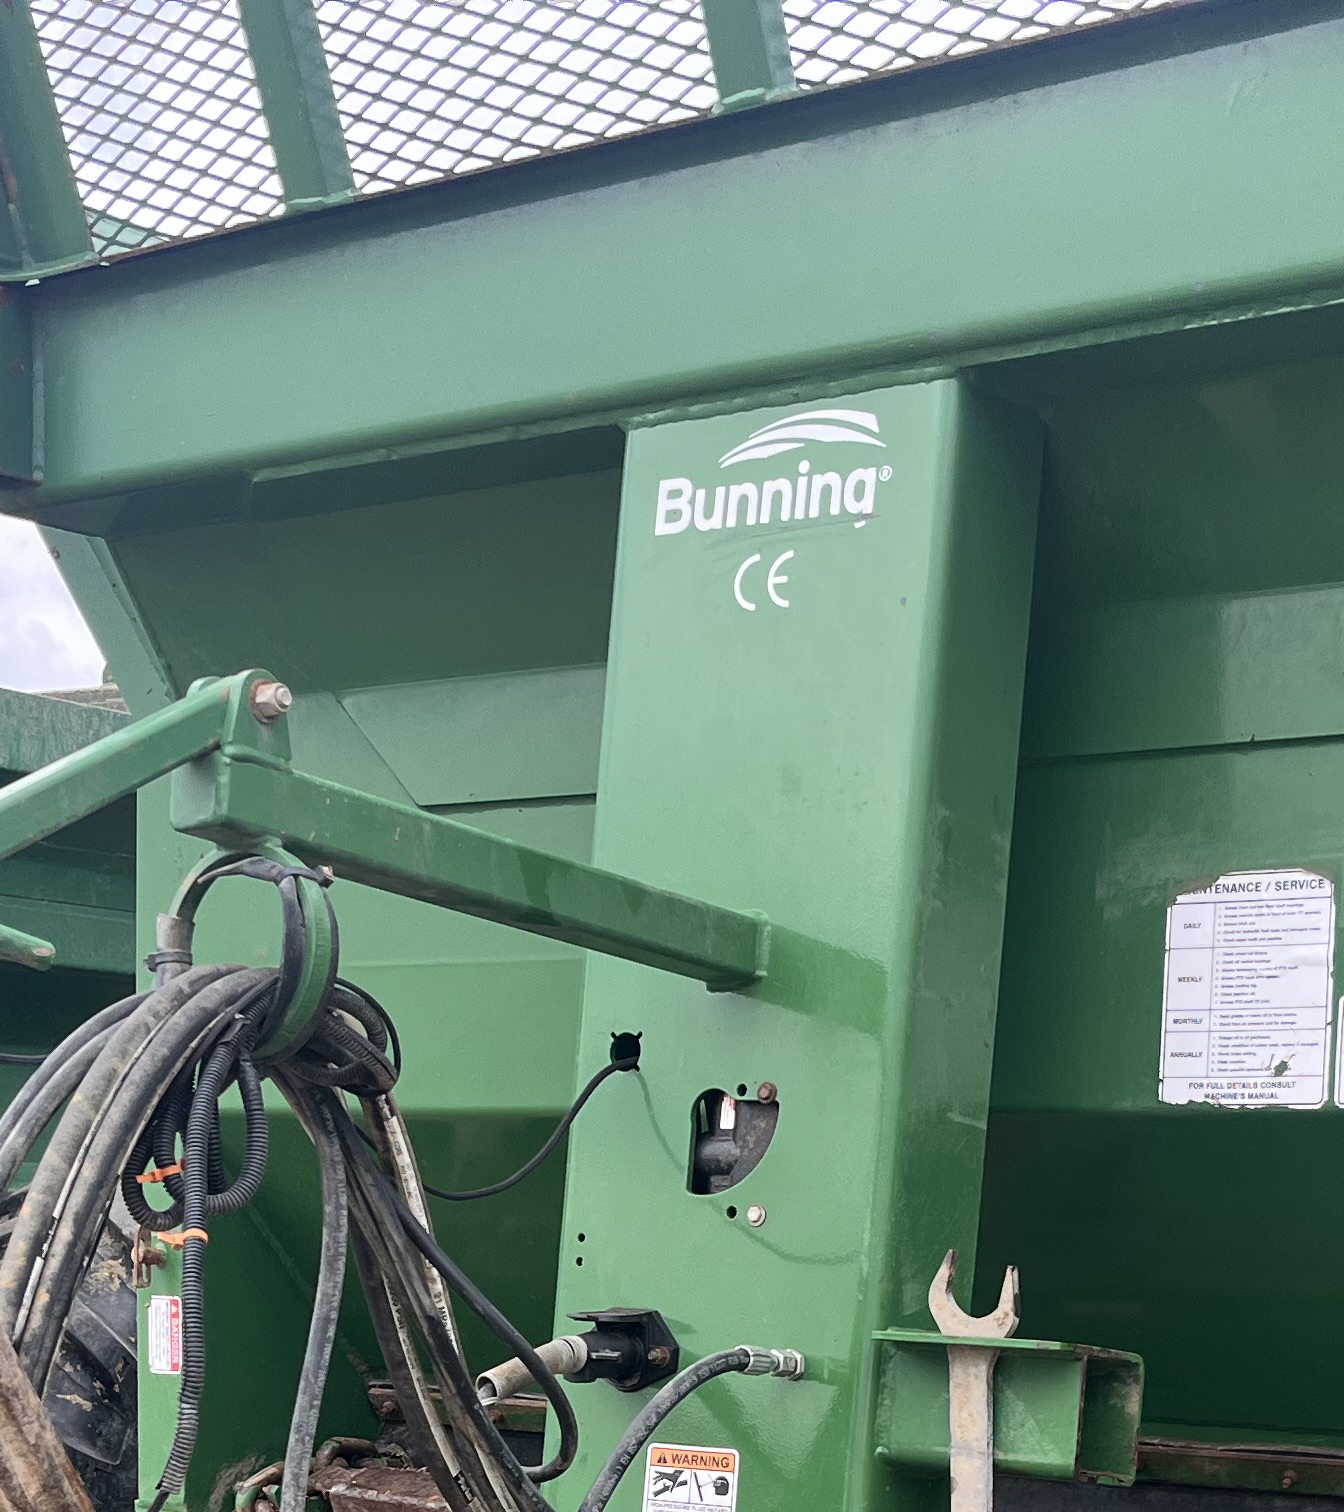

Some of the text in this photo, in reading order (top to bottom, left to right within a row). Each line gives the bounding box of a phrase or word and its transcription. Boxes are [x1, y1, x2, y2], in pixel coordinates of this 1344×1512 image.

[733, 550, 794, 611] CE
[1182, 882, 1261, 895] TENANCE
[1274, 879, 1325, 891] SERVICE
[671, 1453, 730, 1468] WARNING
